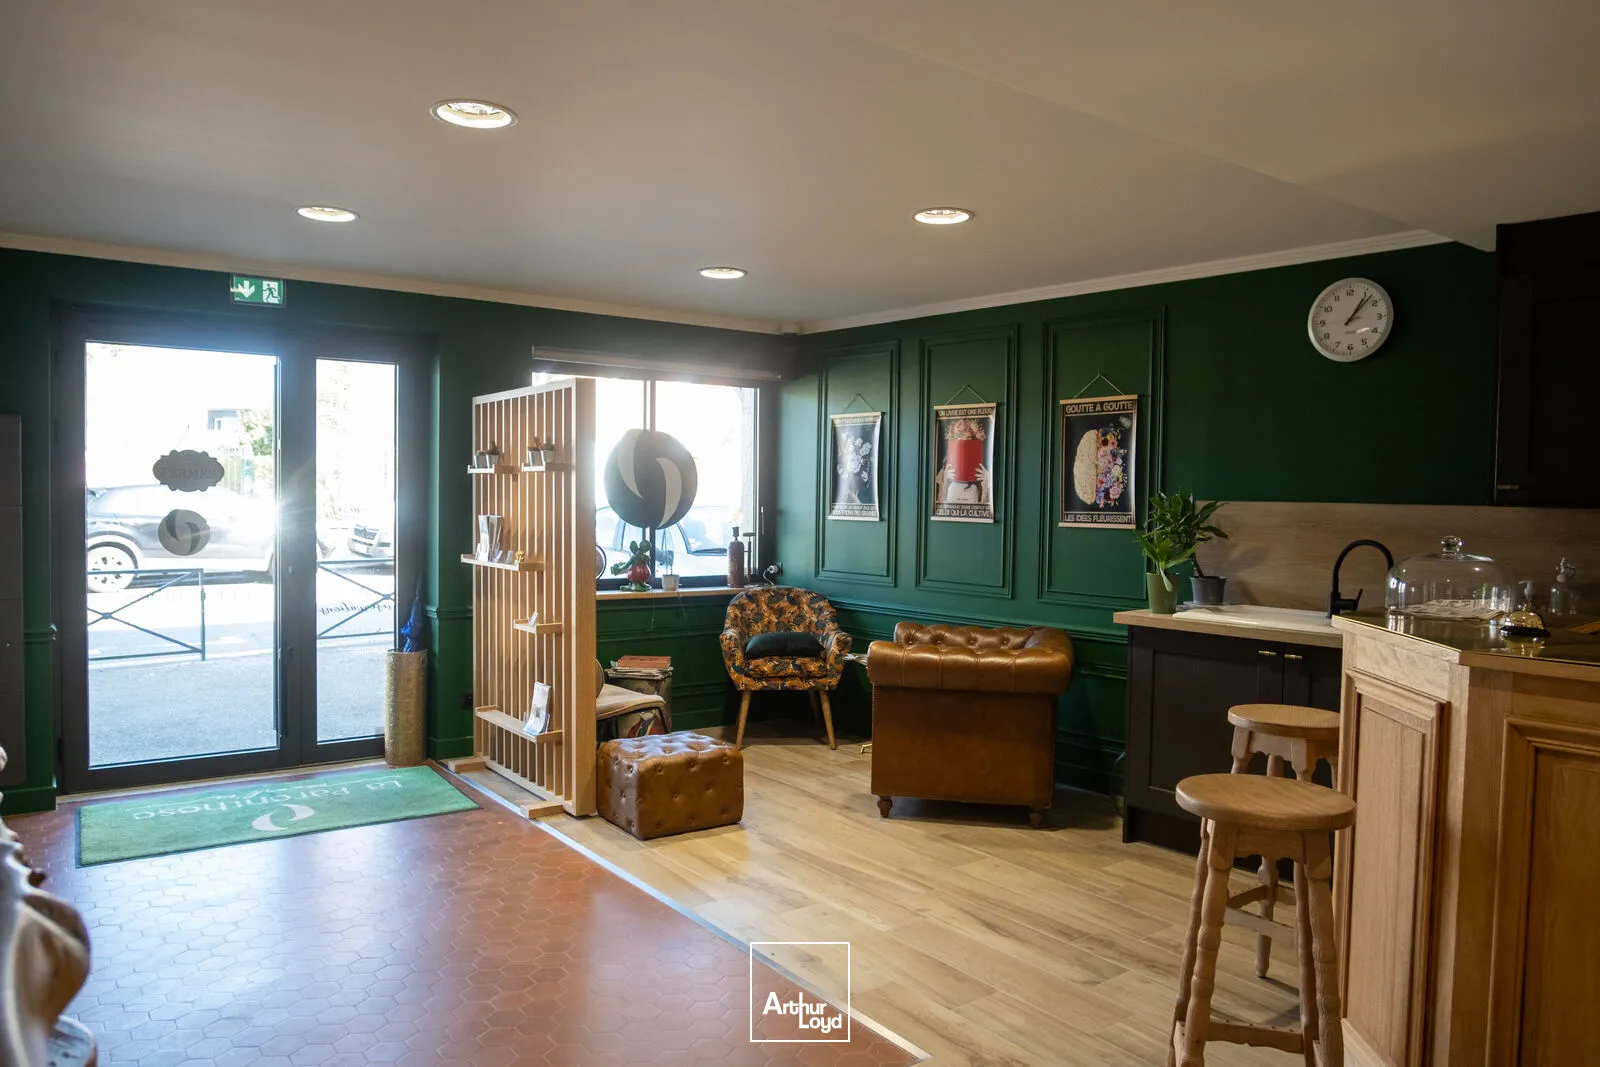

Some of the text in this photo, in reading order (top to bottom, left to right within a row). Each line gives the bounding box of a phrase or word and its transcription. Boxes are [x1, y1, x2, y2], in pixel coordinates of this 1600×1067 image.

[1065, 403, 1094, 414] GOUTTE
[1103, 401, 1133, 412] GOUTTE
[1064, 514, 1076, 522] LES
[1093, 514, 1132, 524] FLEURISSENT
